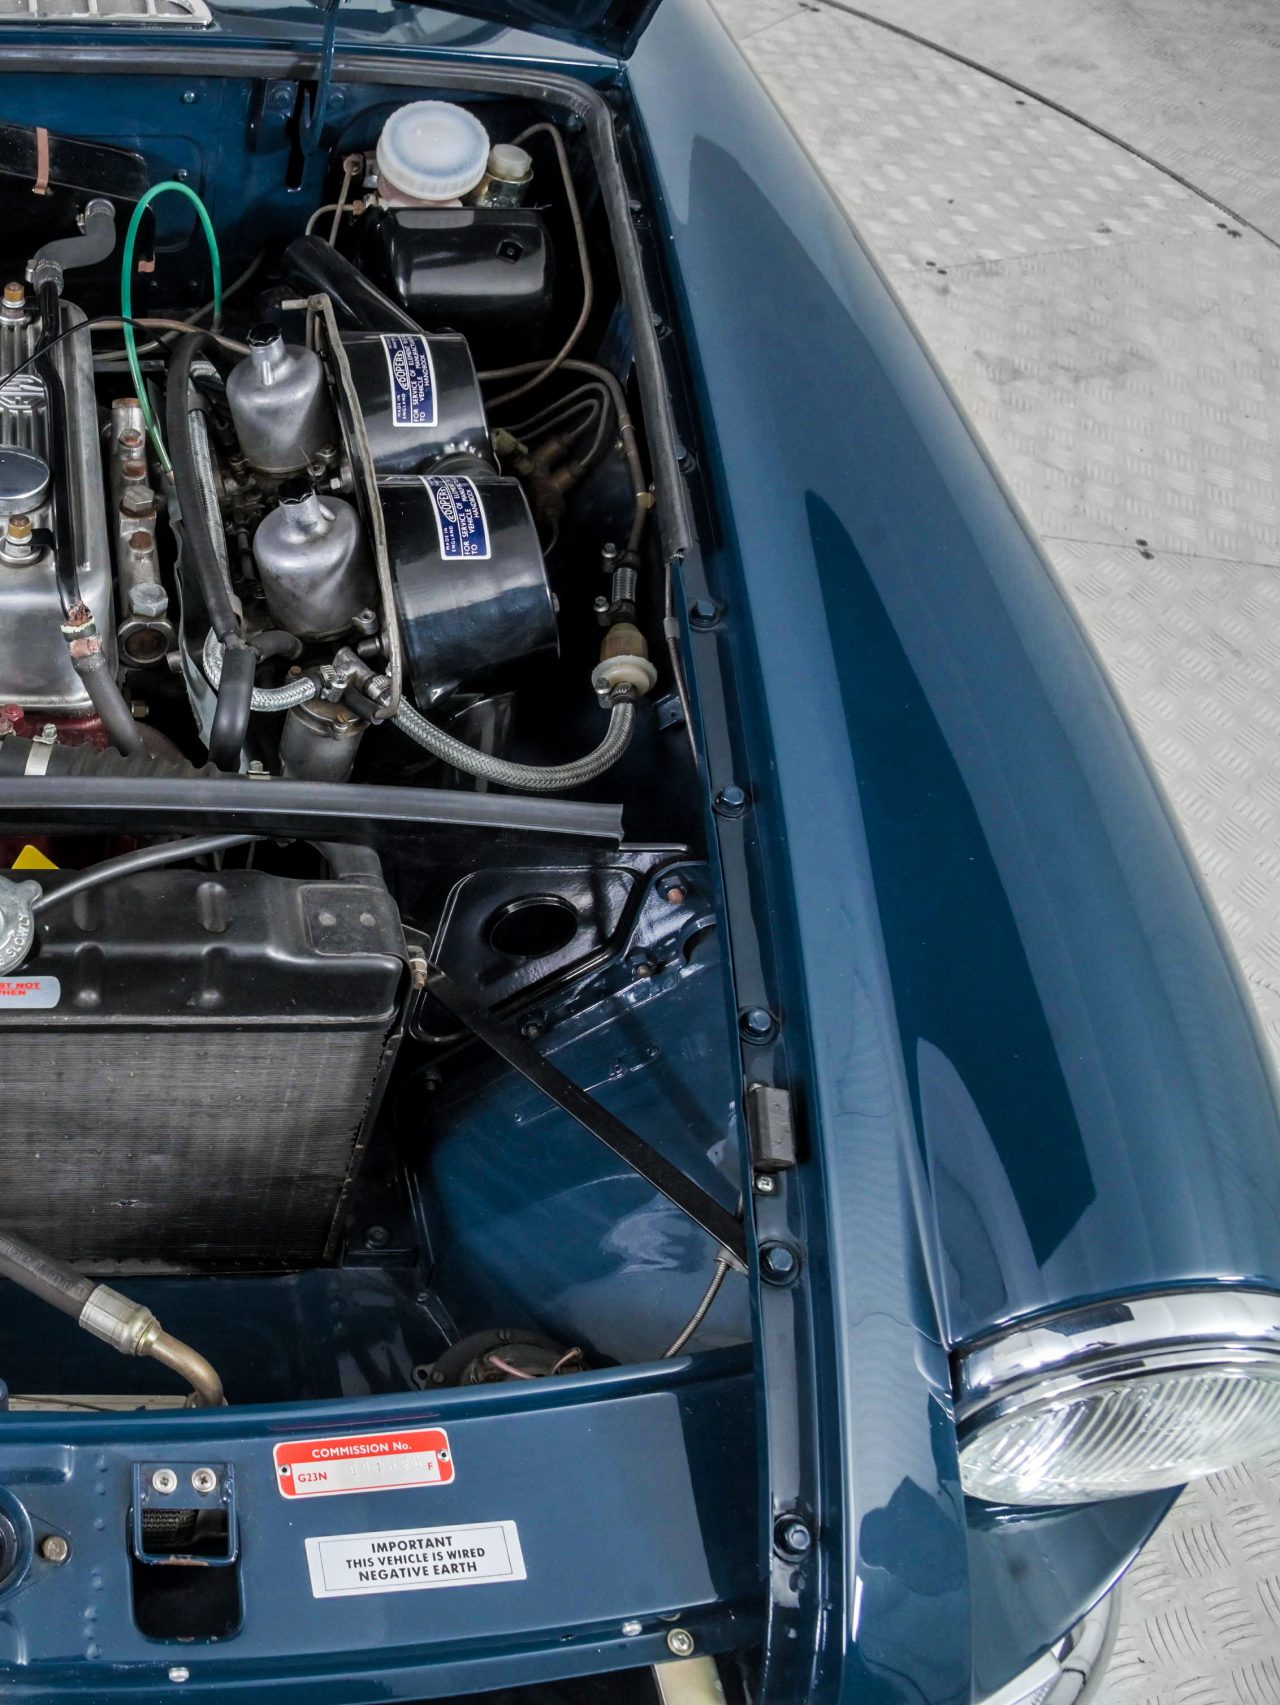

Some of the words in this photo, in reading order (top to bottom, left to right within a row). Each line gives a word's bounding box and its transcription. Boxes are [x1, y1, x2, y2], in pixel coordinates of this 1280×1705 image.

[410, 369, 416, 377] OF
[420, 354, 430, 386] HANDBOOK
[411, 381, 419, 406] SERVICE
[417, 376, 425, 402] VEHICLE
[420, 412, 426, 422] TO
[456, 502, 463, 510] OF
[467, 489, 480, 518] HANDBOOK
[459, 513, 469, 538] SERVICE
[465, 509, 475, 534] VEHICLE
[471, 544, 478, 555] TO
[5, 913, 30, 959] SLOWLY
[312, 1443, 389, 1459] COMMISSION
[393, 1441, 412, 1451] No.
[298, 1472, 328, 1483] G23N
[427, 1462, 434, 1471] F
[371, 1536, 453, 1554] IMPORTANT
[346, 1558, 374, 1569] THIS
[377, 1552, 429, 1566] VEHICLE
[432, 1551, 444, 1562] IS
[446, 1547, 486, 1561] WIRED
[358, 1566, 430, 1582] NEGATIVE
[433, 1562, 478, 1576] EARTH
